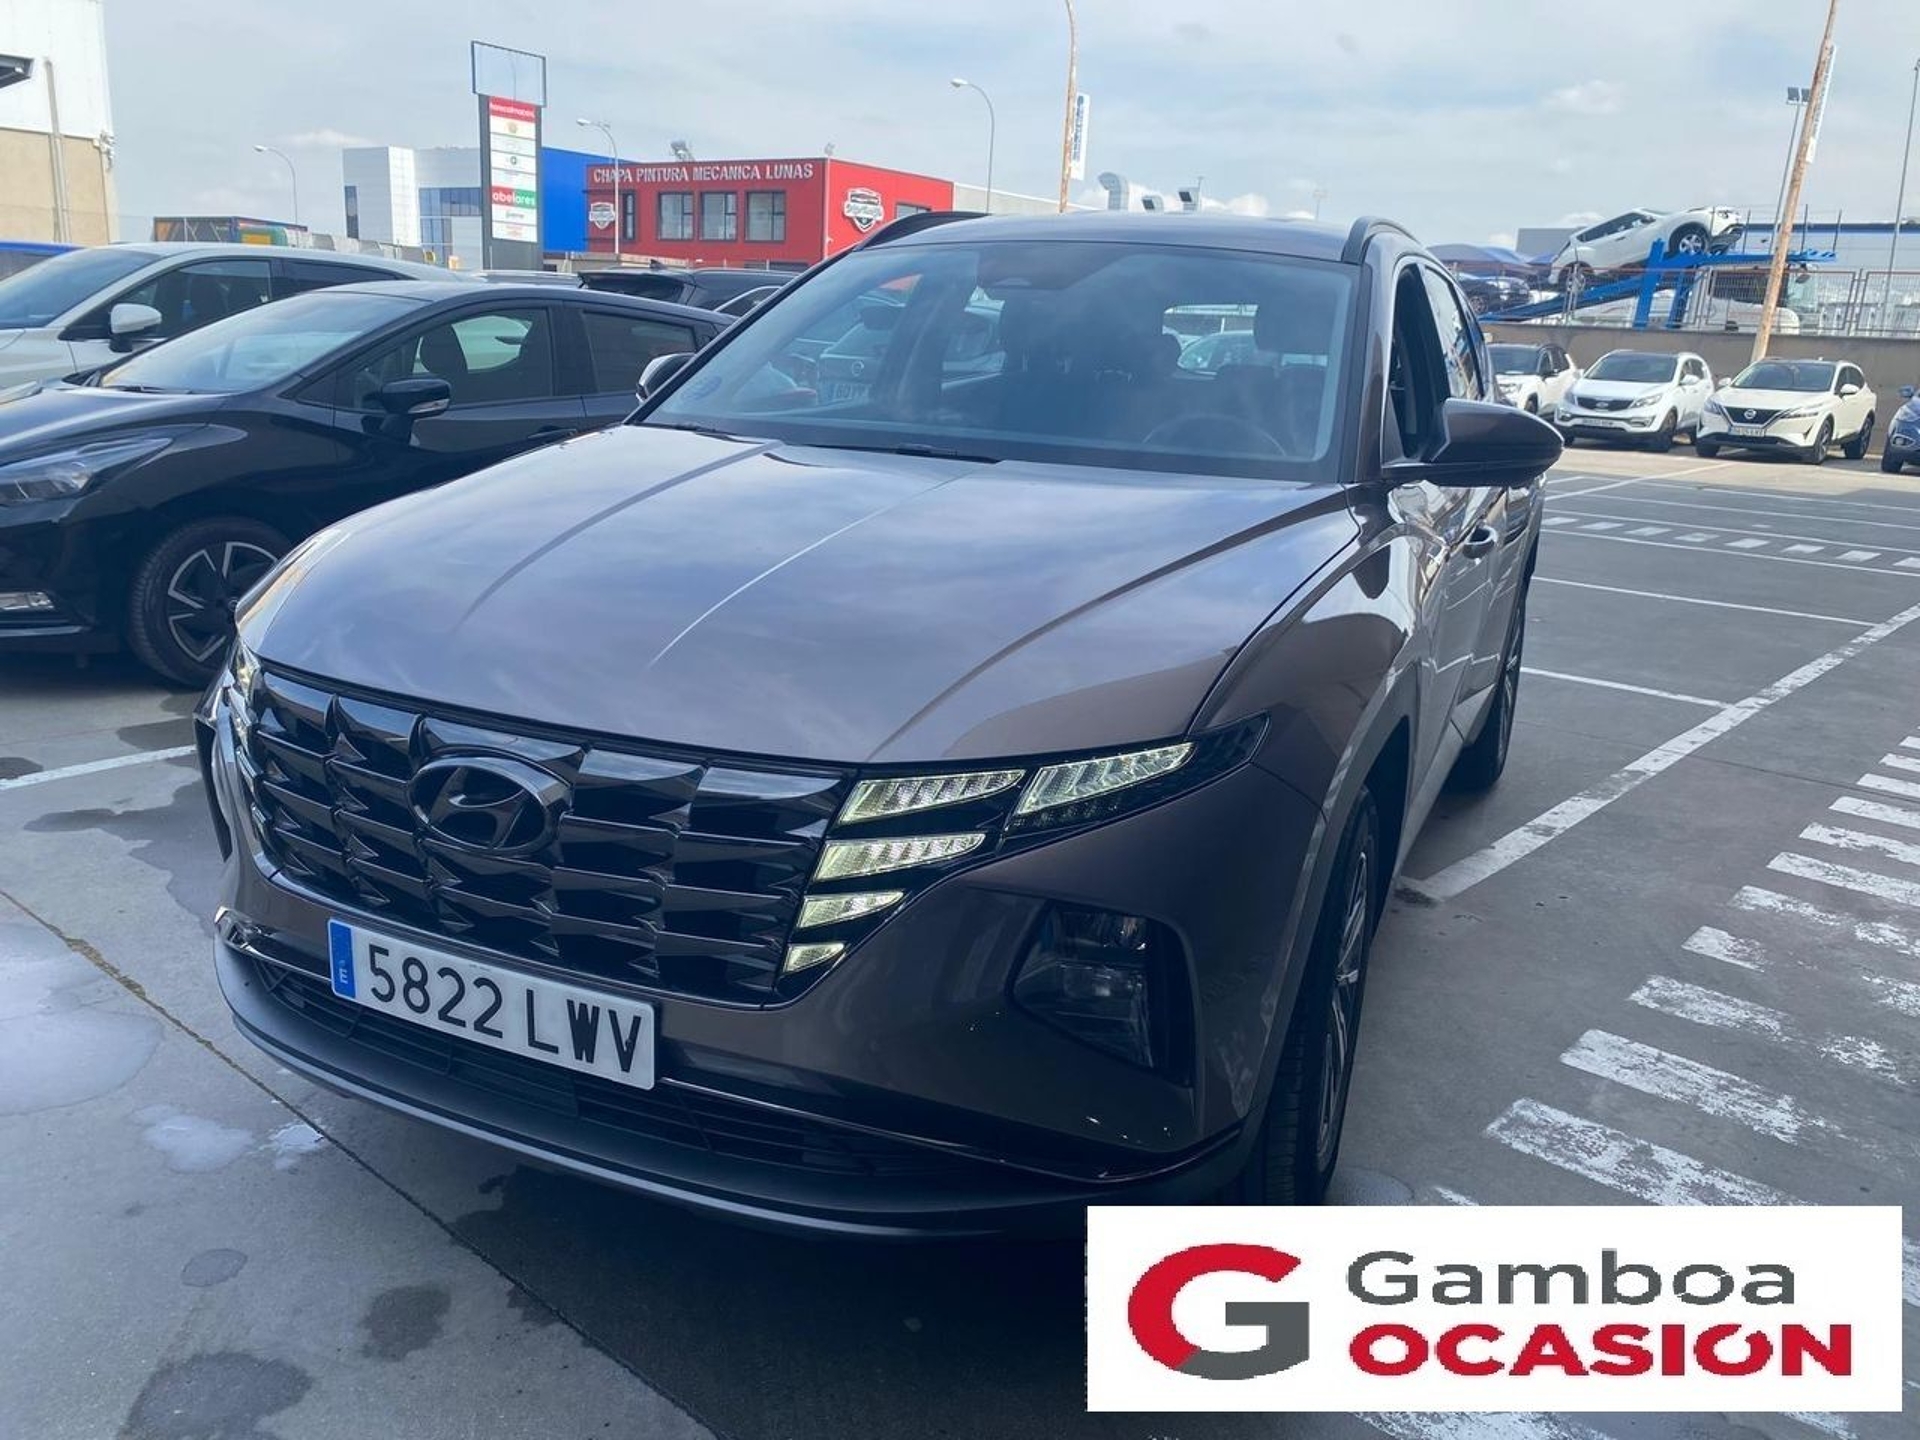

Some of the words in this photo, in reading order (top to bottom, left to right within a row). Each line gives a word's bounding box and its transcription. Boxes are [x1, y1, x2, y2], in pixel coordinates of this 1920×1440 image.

[593, 168, 632, 183] CHAPA
[636, 167, 689, 182] PINTURA
[692, 164, 761, 181] MECANICA
[765, 162, 813, 180] LUNAS
[369, 943, 503, 1039] 5822
[526, 988, 641, 1073] LWV
